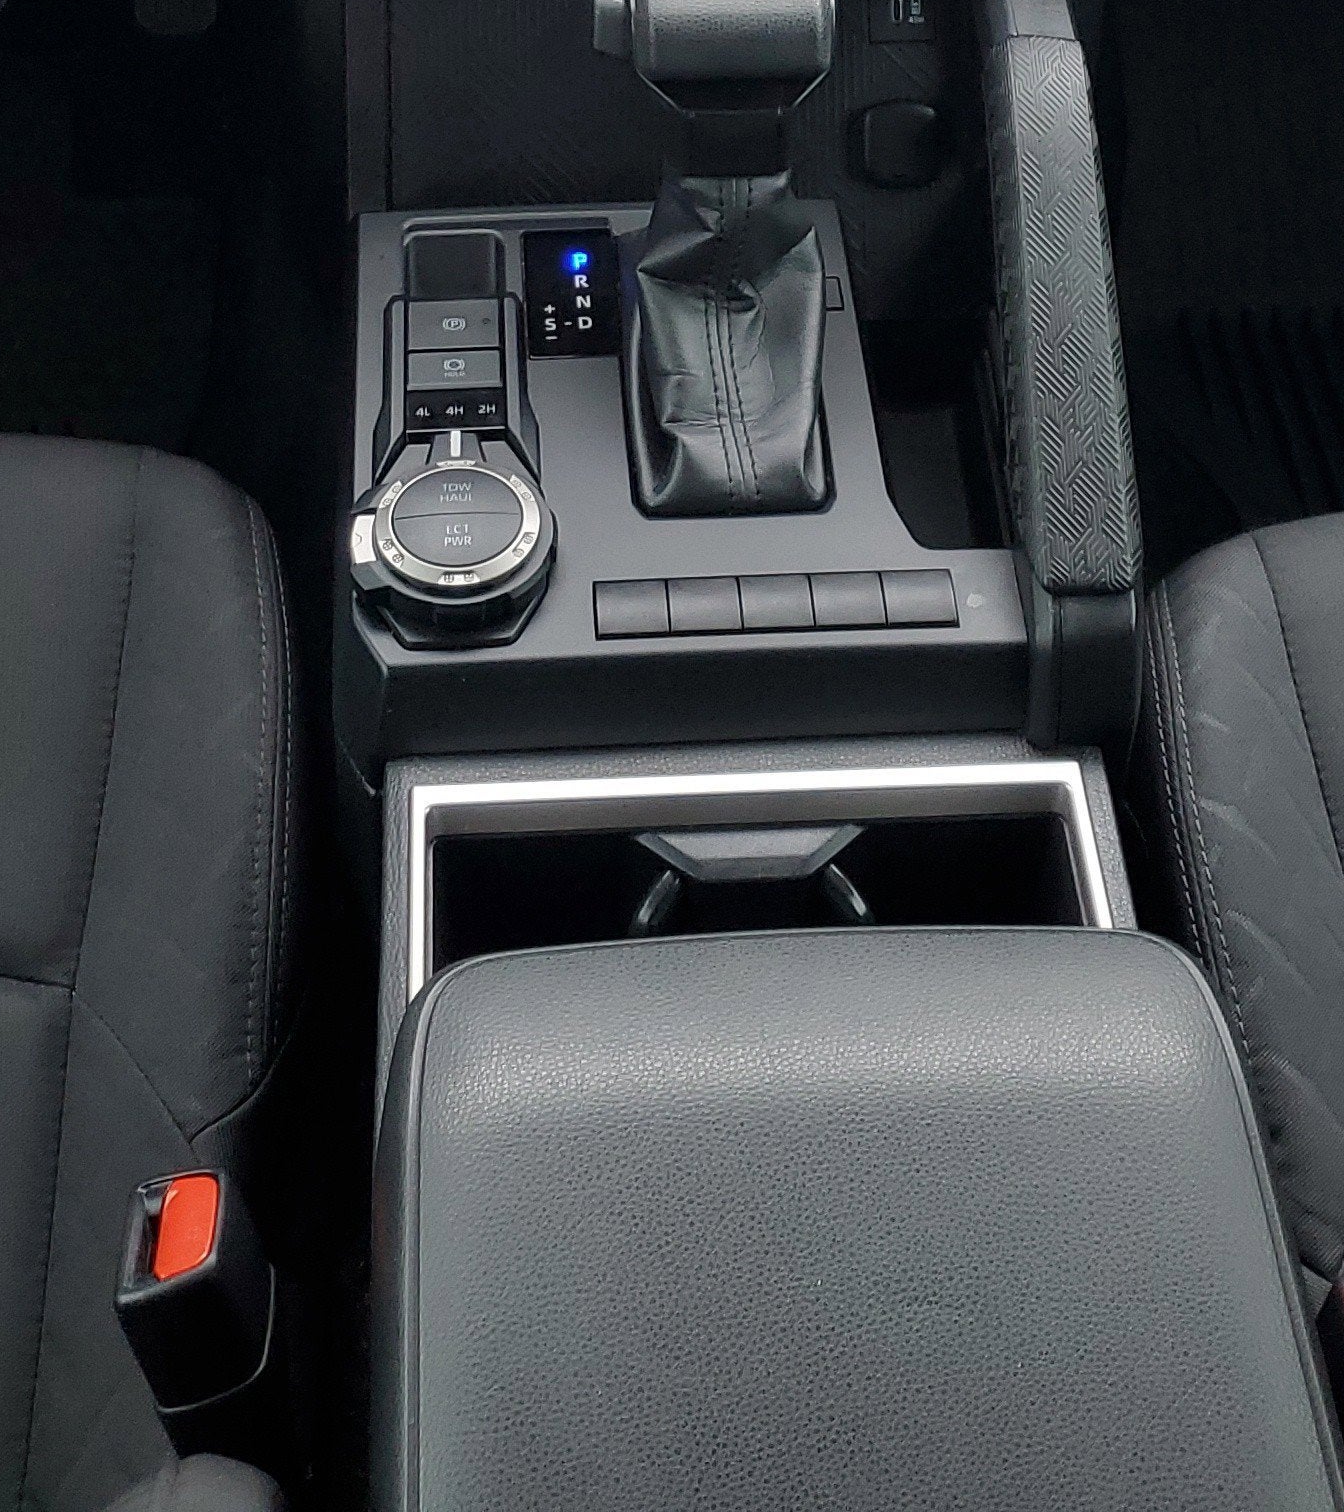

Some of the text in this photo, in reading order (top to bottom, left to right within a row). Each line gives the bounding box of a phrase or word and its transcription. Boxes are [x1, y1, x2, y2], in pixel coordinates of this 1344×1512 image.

[572, 251, 588, 270] P
[574, 274, 590, 288] R
[576, 295, 592, 308] N
[545, 316, 593, 331] S D
[415, 403, 496, 418] 4L 4H 2H
[444, 537, 472, 547] PWR
